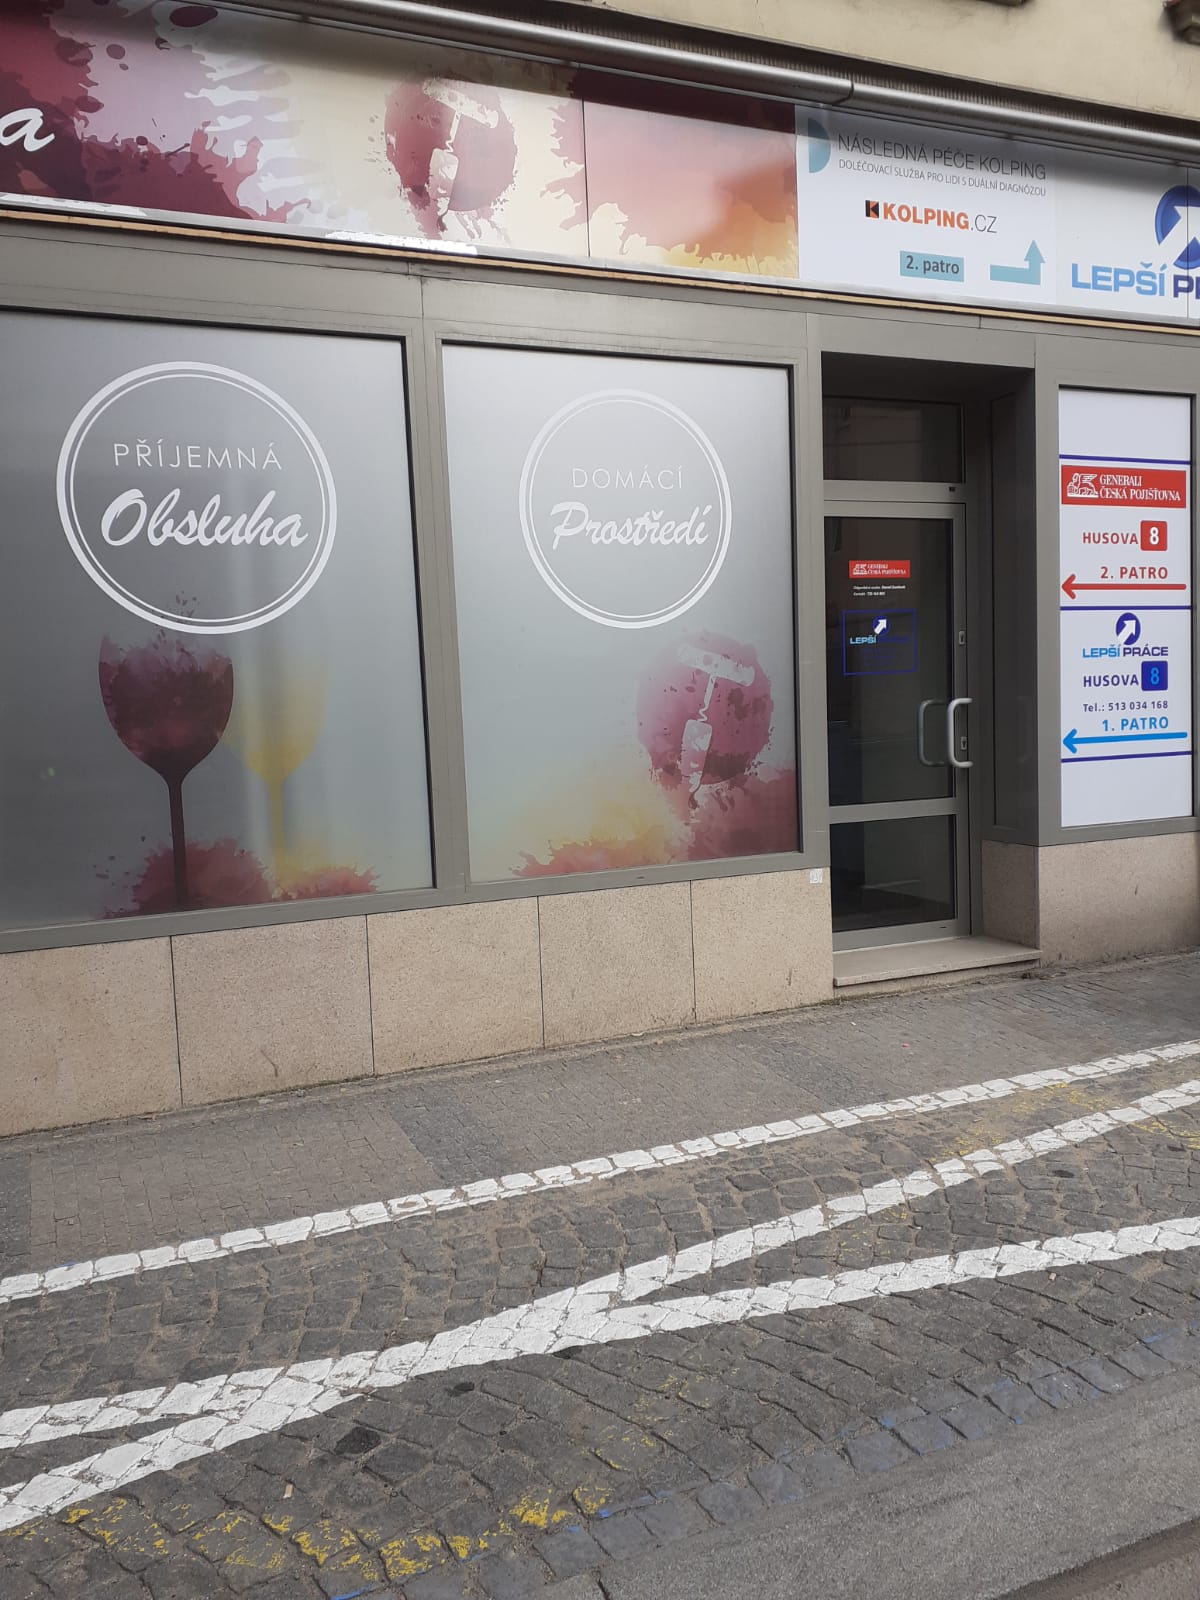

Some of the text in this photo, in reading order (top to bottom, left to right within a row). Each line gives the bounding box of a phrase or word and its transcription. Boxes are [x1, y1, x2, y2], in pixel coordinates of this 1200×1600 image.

[838, 132, 1047, 181] NÁSLEDNÁ PÉČE KOLPING
[839, 157, 1047, 197] DOLÉČOVACÍ SLUŽBA PRO LIDI S DUÁLNÍ DIAGNÓZOU
[883, 201, 998, 234] KOLPING.CZ
[905, 254, 960, 277] 2. patro
[1071, 261, 1200, 300] LEPŠÍ P
[113, 438, 283, 470] PŘÍJEMNÁ
[572, 464, 684, 490] DOMÁCÍ
[1099, 473, 1143, 487] GENERALI
[1099, 485, 1181, 501] ČESKÁ POJIŠŤOVNA
[101, 487, 309, 548] Obsluha
[550, 500, 713, 551] Prostředí
[1082, 526, 1160, 545] HUSOVA 8
[1100, 566, 1168, 580] 2. PATRO
[849, 634, 877, 645] LEPŠÍ
[1082, 643, 1169, 658] LEPŠÍ PRÁCE
[1083, 667, 1160, 688] HUSOVA 8
[1083, 700, 1169, 713] Tel.: 513 034 168
[1102, 716, 1169, 732] 1. PATRO
